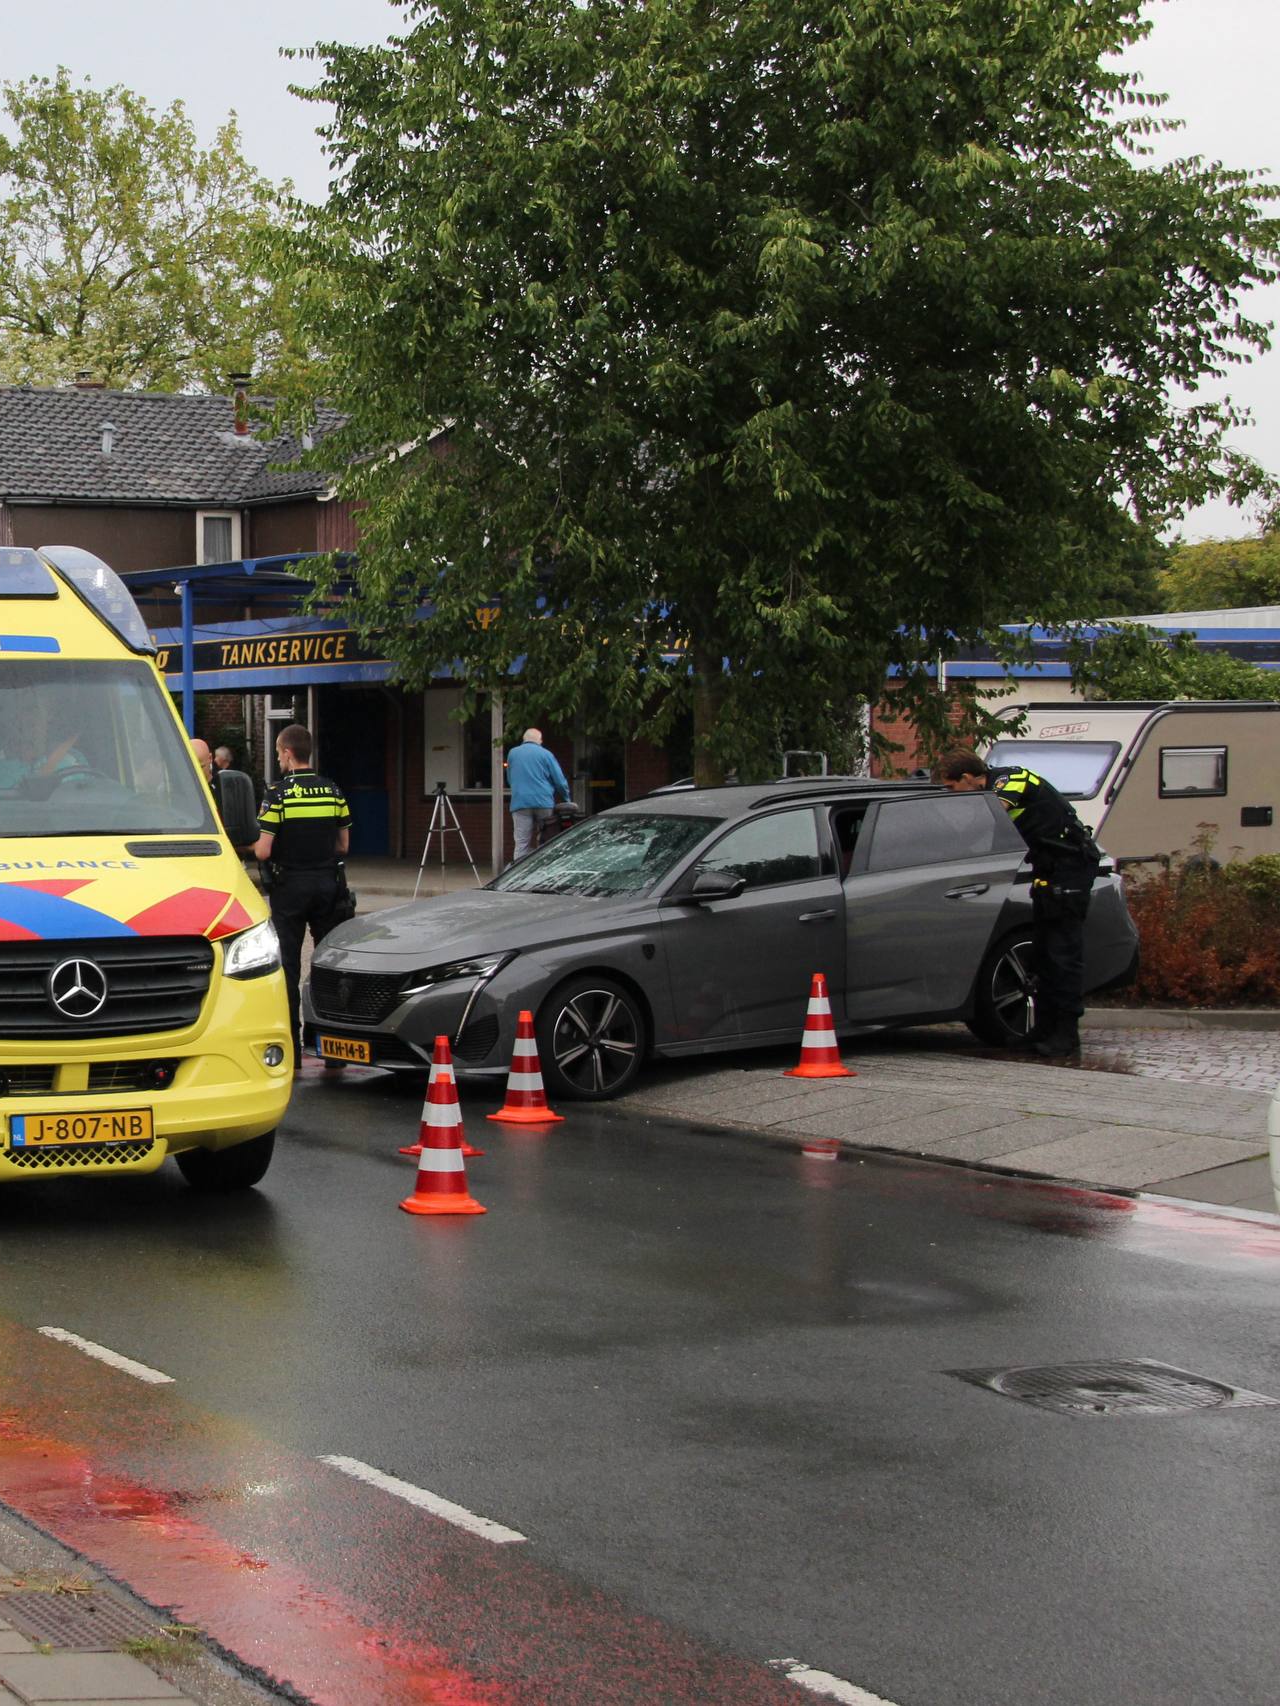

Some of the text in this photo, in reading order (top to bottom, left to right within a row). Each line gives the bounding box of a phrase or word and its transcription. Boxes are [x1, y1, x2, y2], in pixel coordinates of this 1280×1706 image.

[221, 636, 346, 666] TANKSERVICE
[1040, 722, 1089, 737] SHELTER
[287, 783, 330, 798] POLITIE
[33, 1115, 144, 1142] J-807-NB
